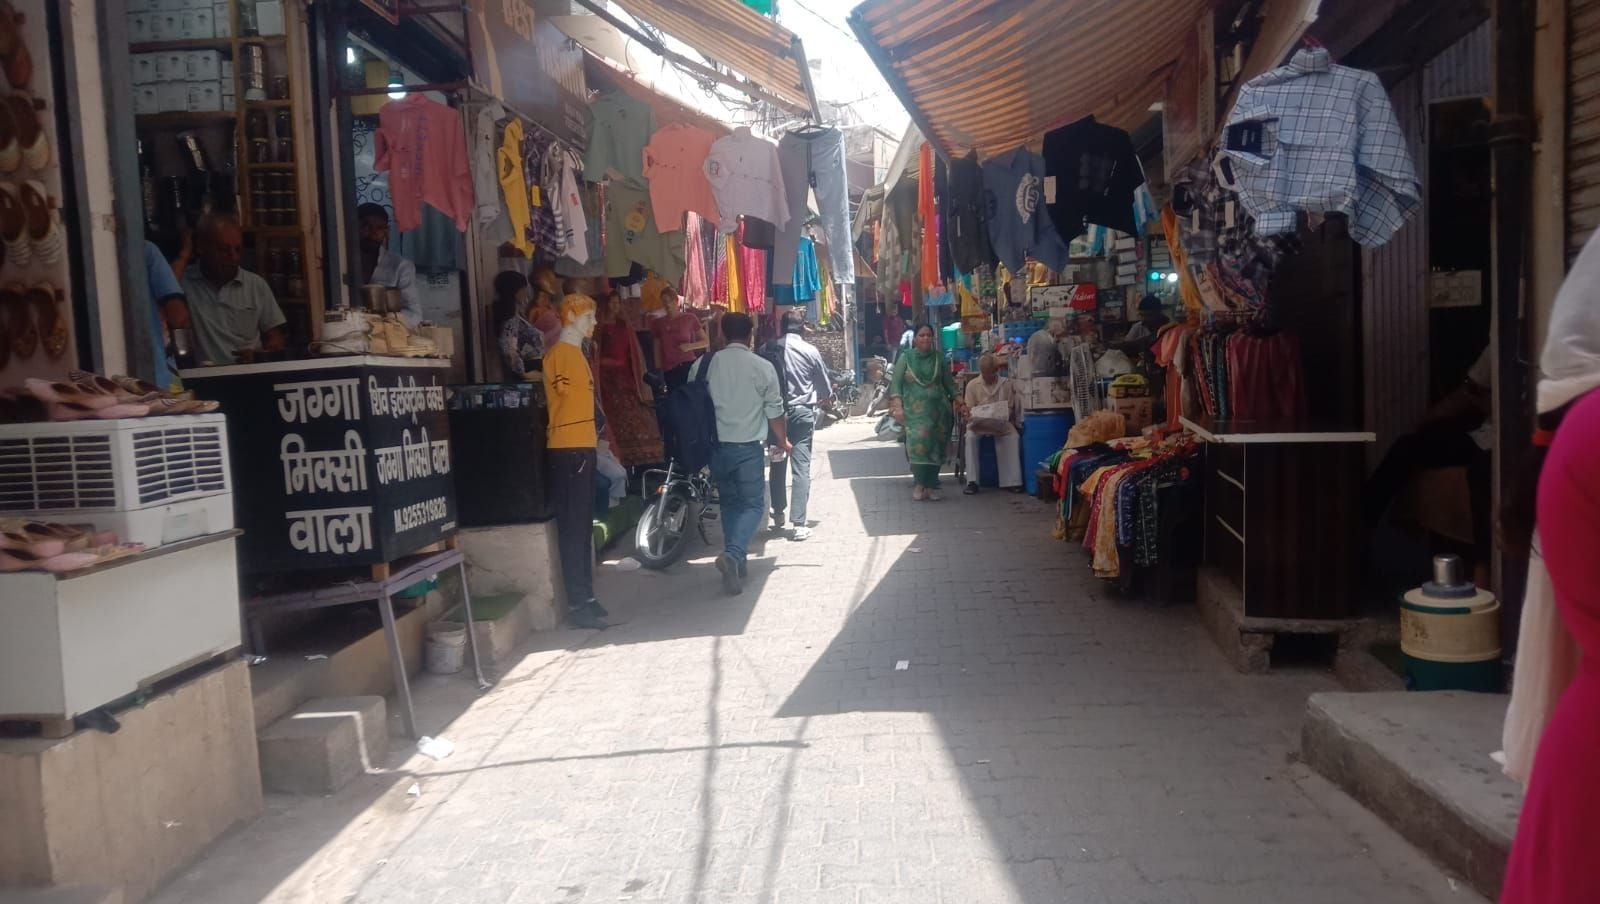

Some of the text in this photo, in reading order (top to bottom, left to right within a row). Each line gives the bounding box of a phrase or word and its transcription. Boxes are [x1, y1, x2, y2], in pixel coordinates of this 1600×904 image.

[273, 378, 361, 424] जग्गा
[368, 375, 389, 416] शिव
[280, 429, 368, 495] मिक्सी
[374, 427, 450, 485] जग्गा मिक्सी वाला
[285, 505, 373, 555] वाला
